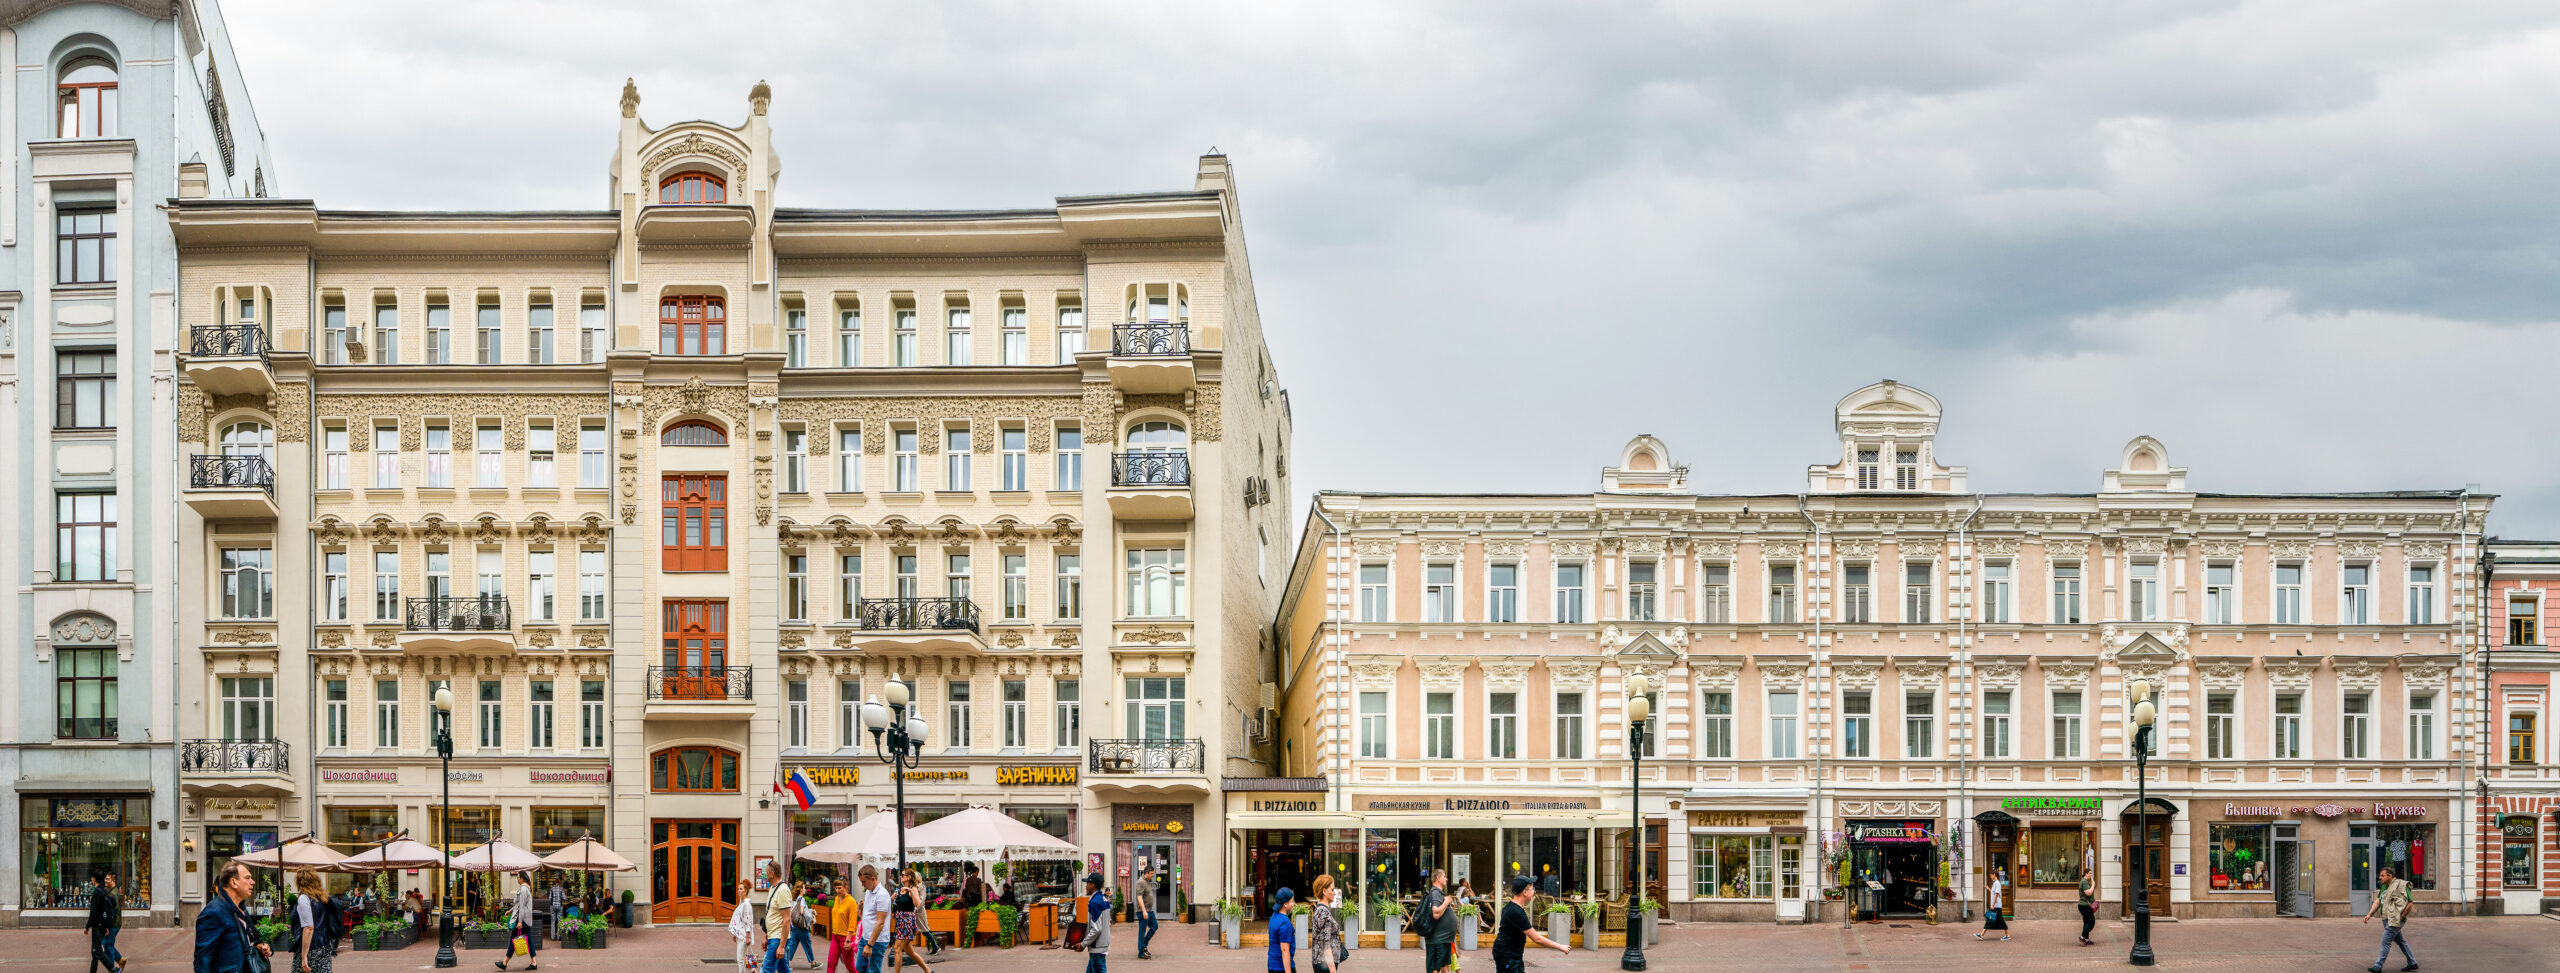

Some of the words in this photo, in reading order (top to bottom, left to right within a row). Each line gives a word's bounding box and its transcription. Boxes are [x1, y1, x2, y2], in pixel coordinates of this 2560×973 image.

[323, 769, 397, 784] Шоколадница
[447, 770, 483, 784] офейня
[530, 770, 605, 784] Шоколадница
[784, 767, 859, 785] ВЕНИЧНАЯ
[947, 771, 968, 779] КАФЕ
[996, 767, 1076, 784] ВАРЕНИЧНАЯ
[1254, 801, 1263, 811] IL
[1265, 801, 1317, 811] PIZZAIOLO
[1368, 801, 1410, 809] ИТАЛЬЯНСКАЯ
[1410, 801, 1431, 809] КУХНЯ
[1445, 799, 1455, 810] IL
[1457, 800, 1510, 810] PIZZAIOLO
[1525, 802, 1546, 810] ITALIAN
[1547, 802, 1564, 810] PIZZA
[1569, 802, 1587, 810] PASTA
[2001, 797, 2103, 809] АНТИКВАРИАТ
[2224, 802, 2282, 817] Вышивка
[2373, 802, 2427, 820] Кружево
[1697, 812, 1752, 826] РАРИТЕТ
[1123, 823, 1159, 831] ВАРЕНИЧНАЯ
[1865, 828, 1904, 837] PTASHKA
